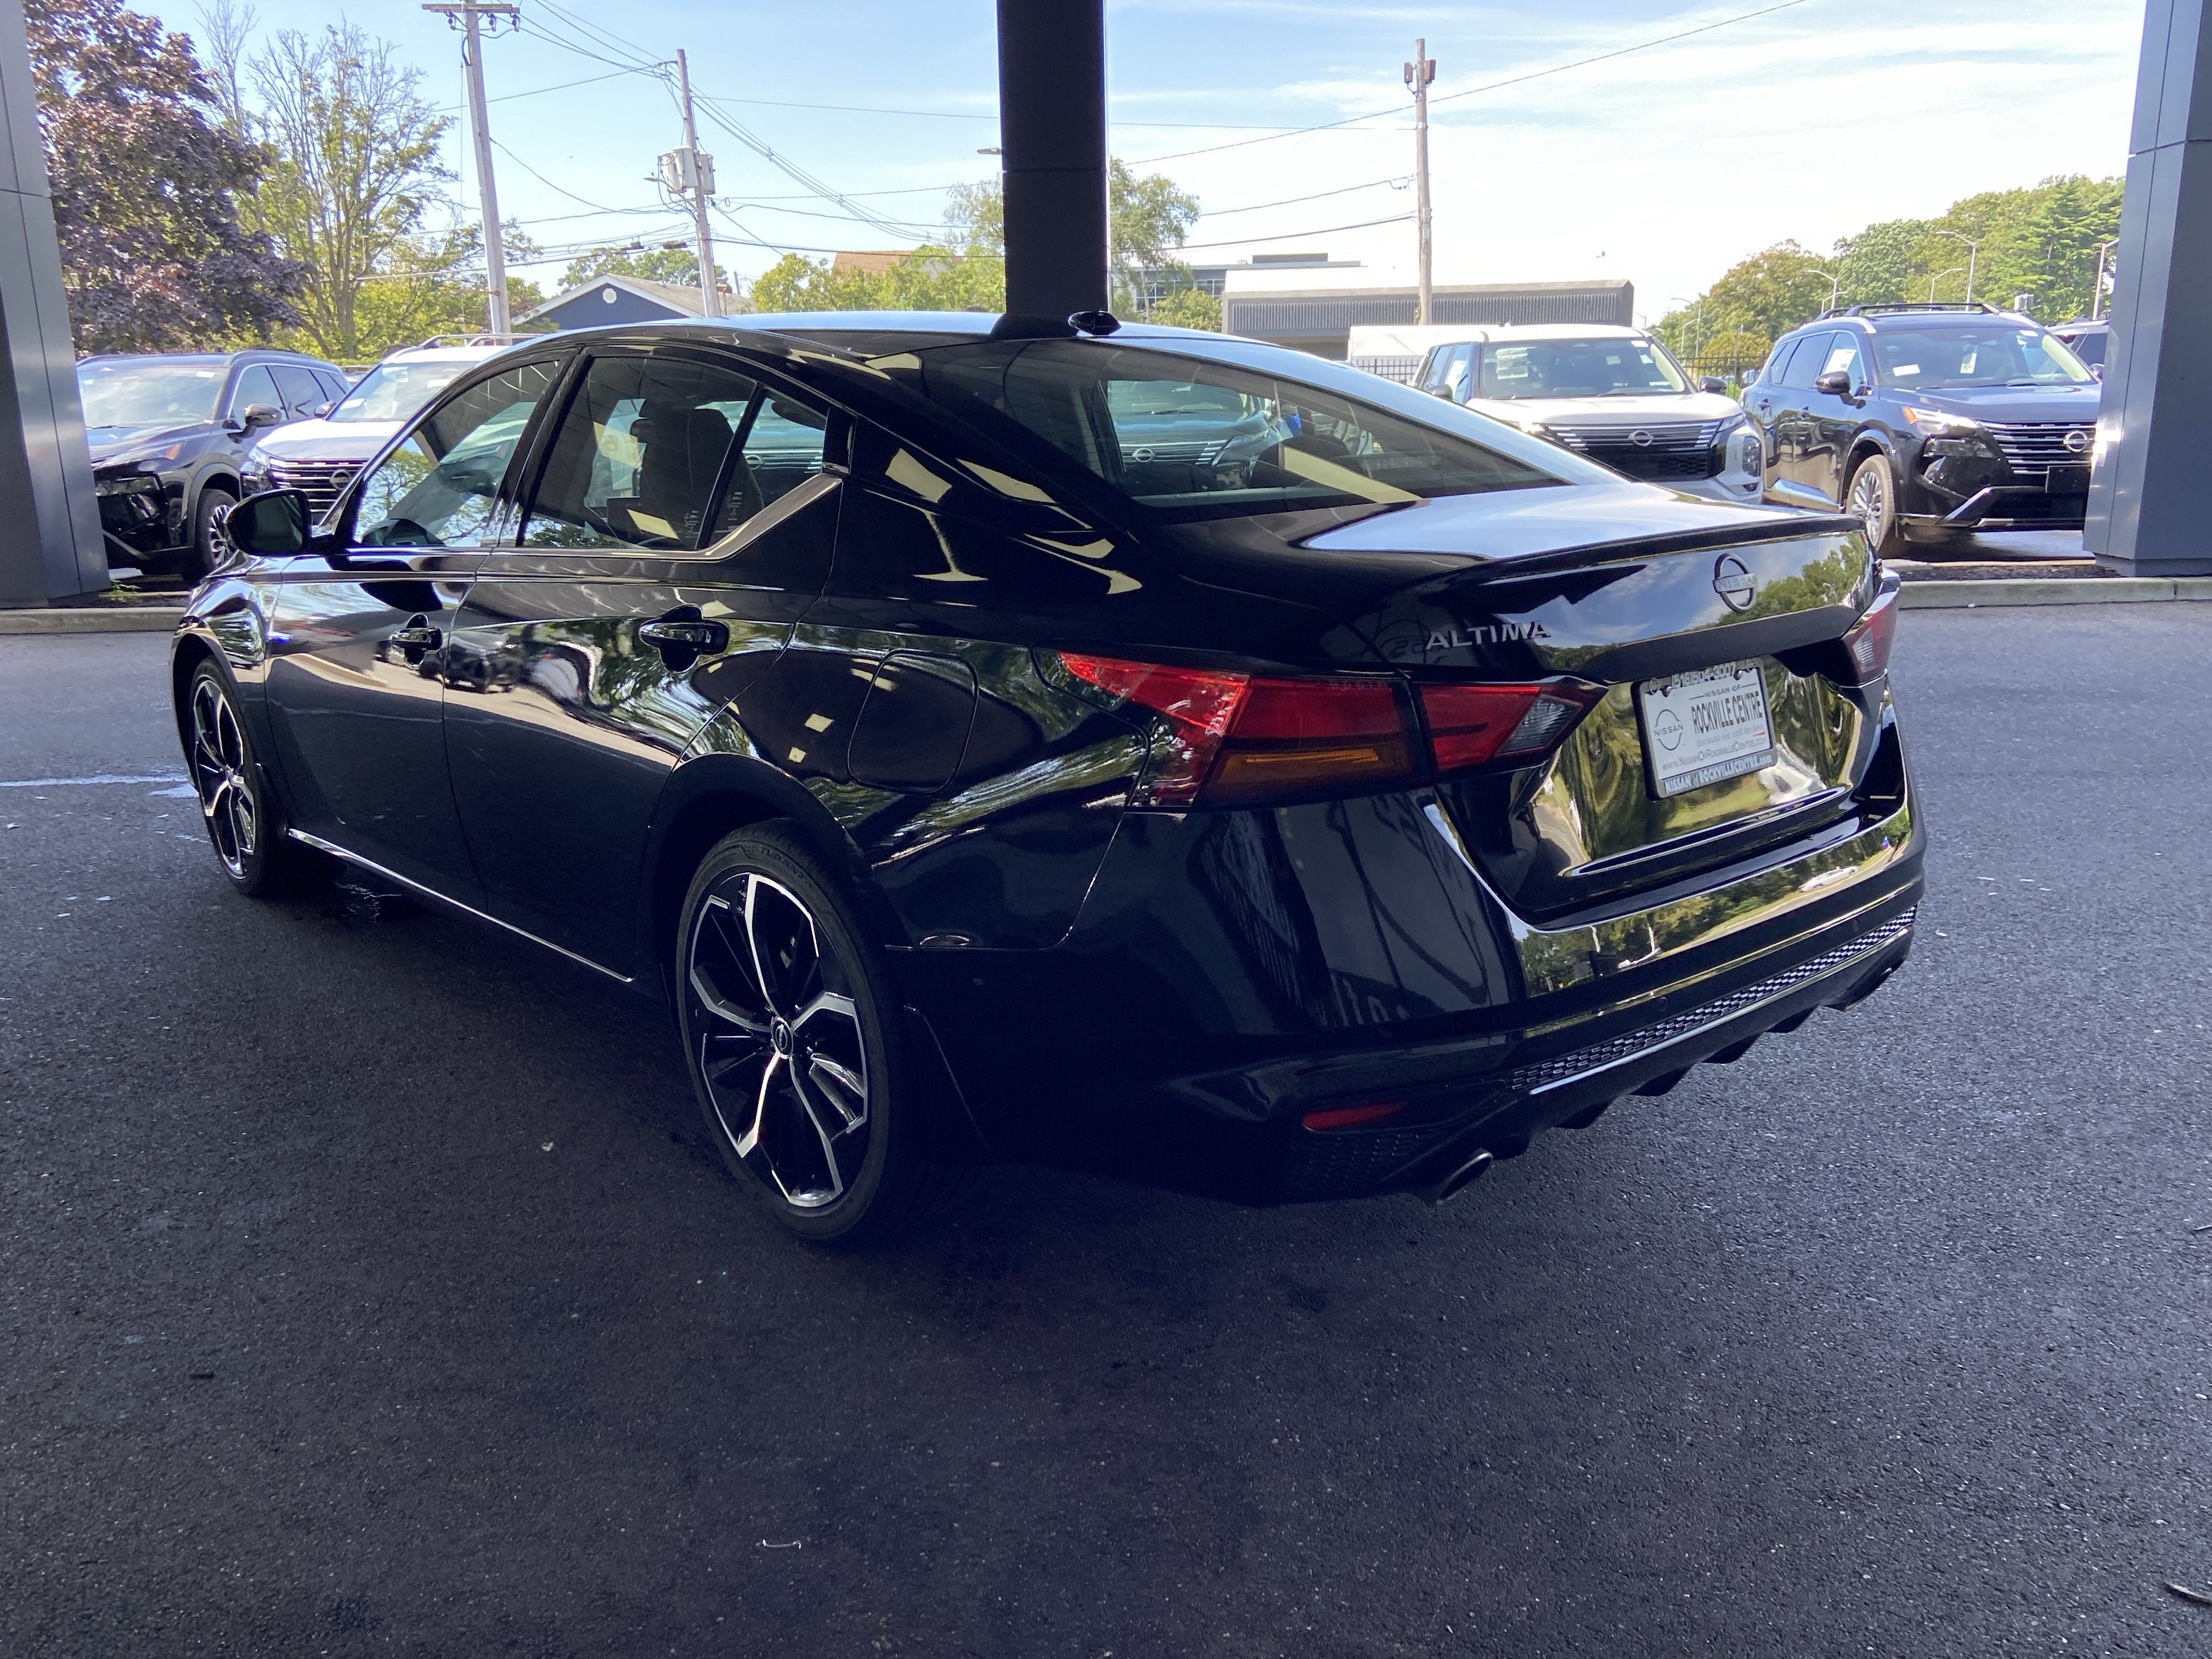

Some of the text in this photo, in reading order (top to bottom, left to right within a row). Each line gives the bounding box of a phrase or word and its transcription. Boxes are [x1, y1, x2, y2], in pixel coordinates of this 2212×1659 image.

[1425, 620, 1552, 650] ALTIMA
[1705, 687, 1730, 697] NISSAN
[1691, 691, 1763, 735] ROCKVILLE CENTRE
[1654, 723, 1683, 737] NISSAN
[1664, 775, 1692, 794] NISSAN
[760, 846, 812, 890] TURANZA
